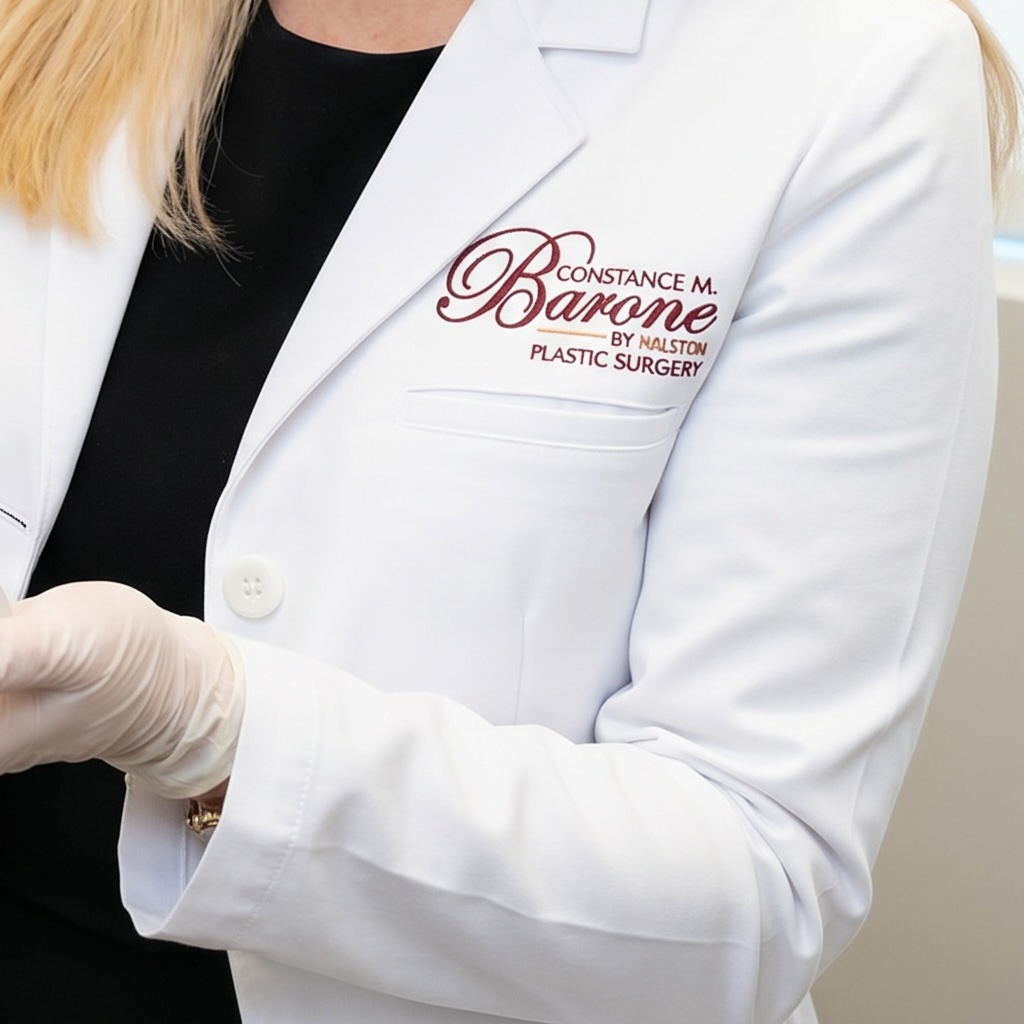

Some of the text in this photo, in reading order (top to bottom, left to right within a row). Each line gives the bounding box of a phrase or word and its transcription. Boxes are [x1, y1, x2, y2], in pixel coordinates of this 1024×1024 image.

[436, 227, 718, 334] Barone
[556, 265, 718, 295] CONSTANCE M.
[611, 331, 635, 348] BY
[530, 344, 703, 377] PLASTIC SURGERY
